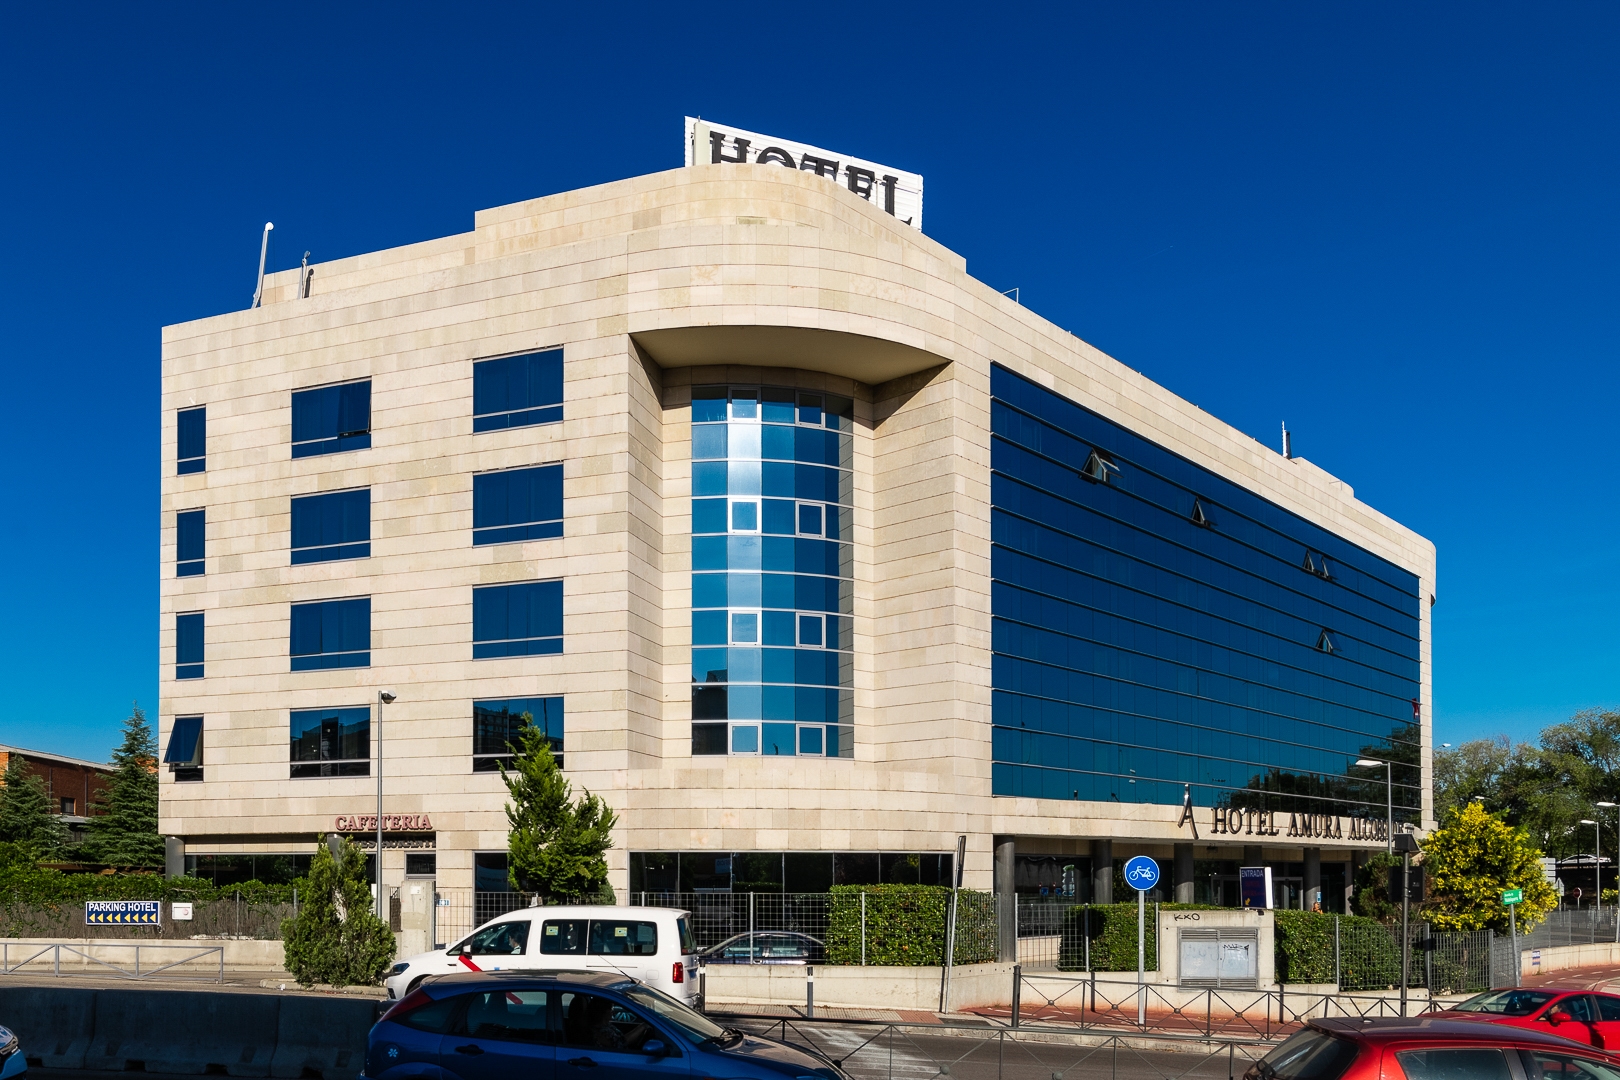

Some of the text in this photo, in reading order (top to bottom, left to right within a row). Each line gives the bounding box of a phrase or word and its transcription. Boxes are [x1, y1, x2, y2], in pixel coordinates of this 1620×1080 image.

[710, 130, 912, 226] HOTEL
[335, 815, 433, 831] CAFETERIA
[1211, 807, 1279, 836] HOTEL
[1286, 812, 1342, 839] AMURA
[1241, 869, 1264, 877] ENTRADA
[88, 902, 156, 912] PARKING HOTEL
